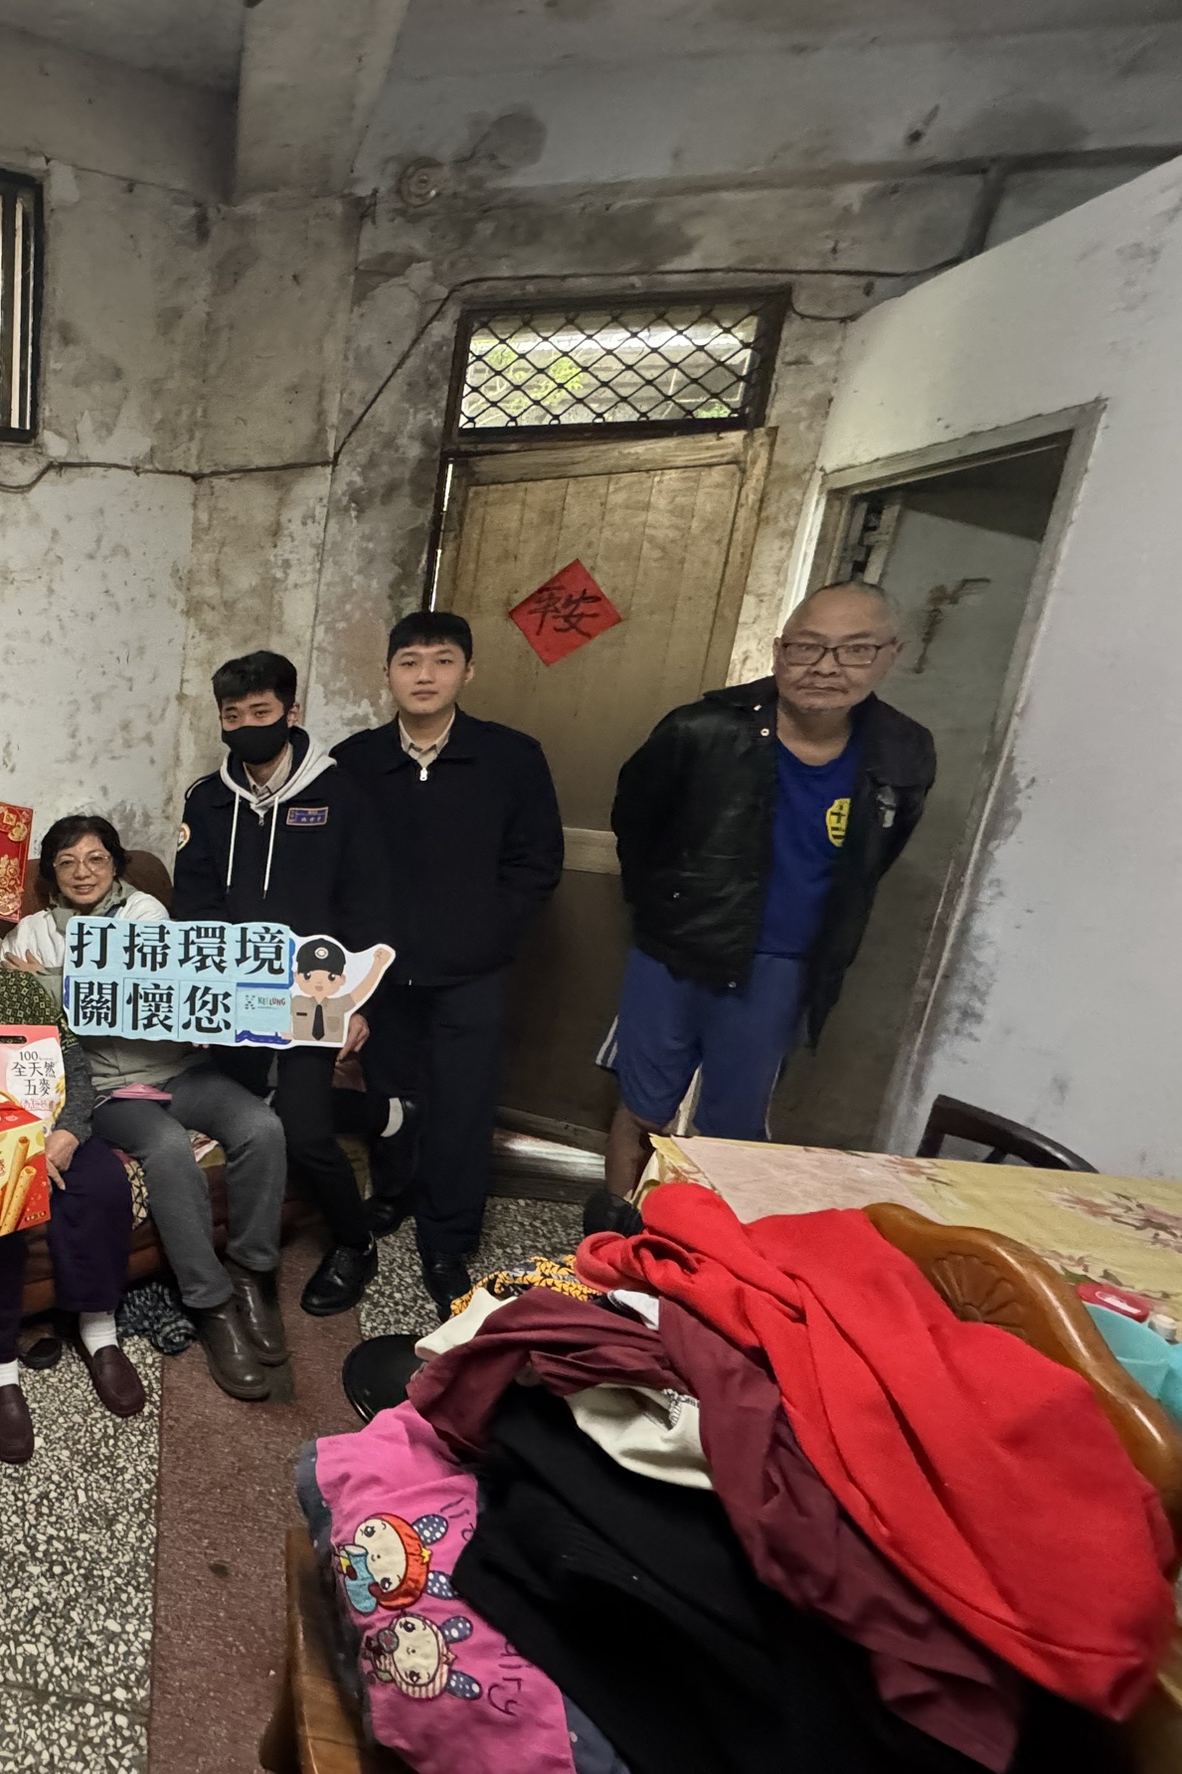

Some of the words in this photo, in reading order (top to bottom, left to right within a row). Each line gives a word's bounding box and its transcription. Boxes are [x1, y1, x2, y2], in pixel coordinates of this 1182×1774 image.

[69, 922, 286, 976] 打掃環境
[72, 980, 233, 1035] 關懷您
[19, 1050, 38, 1061] 100
[11, 1060, 57, 1078] 全天然
[24, 1078, 51, 1097] 五麥
